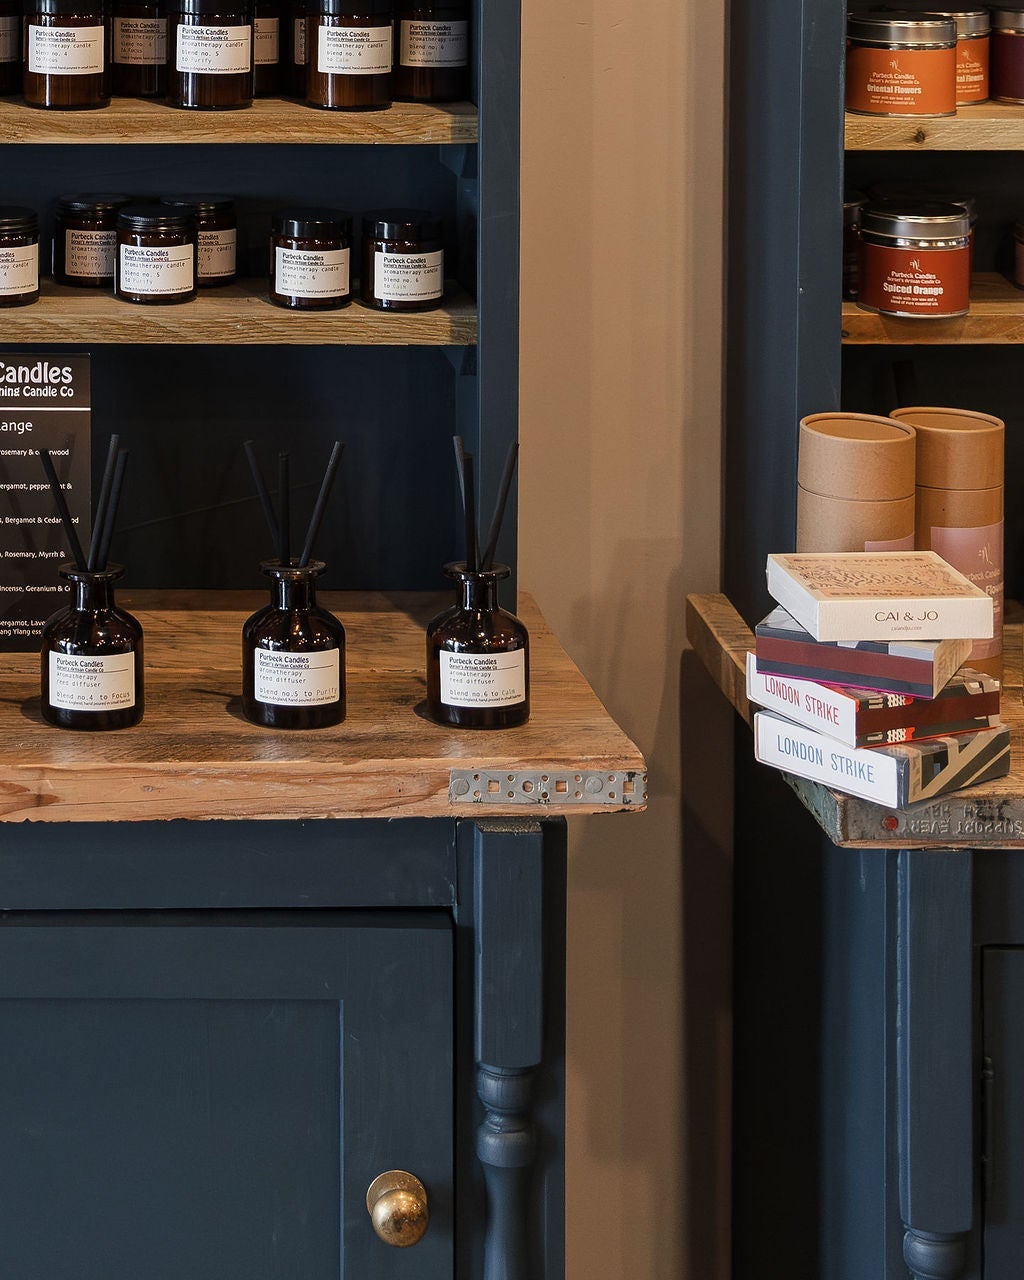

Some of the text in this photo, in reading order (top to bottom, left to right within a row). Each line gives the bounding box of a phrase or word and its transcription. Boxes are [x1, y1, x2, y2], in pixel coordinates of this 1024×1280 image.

[867, 84, 922, 95] Oriental Flowers
[883, 282, 944, 295] Spiced Orange
[23, 386, 57, 397] Candle
[60, 386, 74, 397] Co
[875, 611, 938, 621] CAI & JO
[57, 658, 78, 666] Purbeck
[765, 675, 839, 726] LONDON STRIKE
[777, 734, 875, 783] LONDON STRIKE
